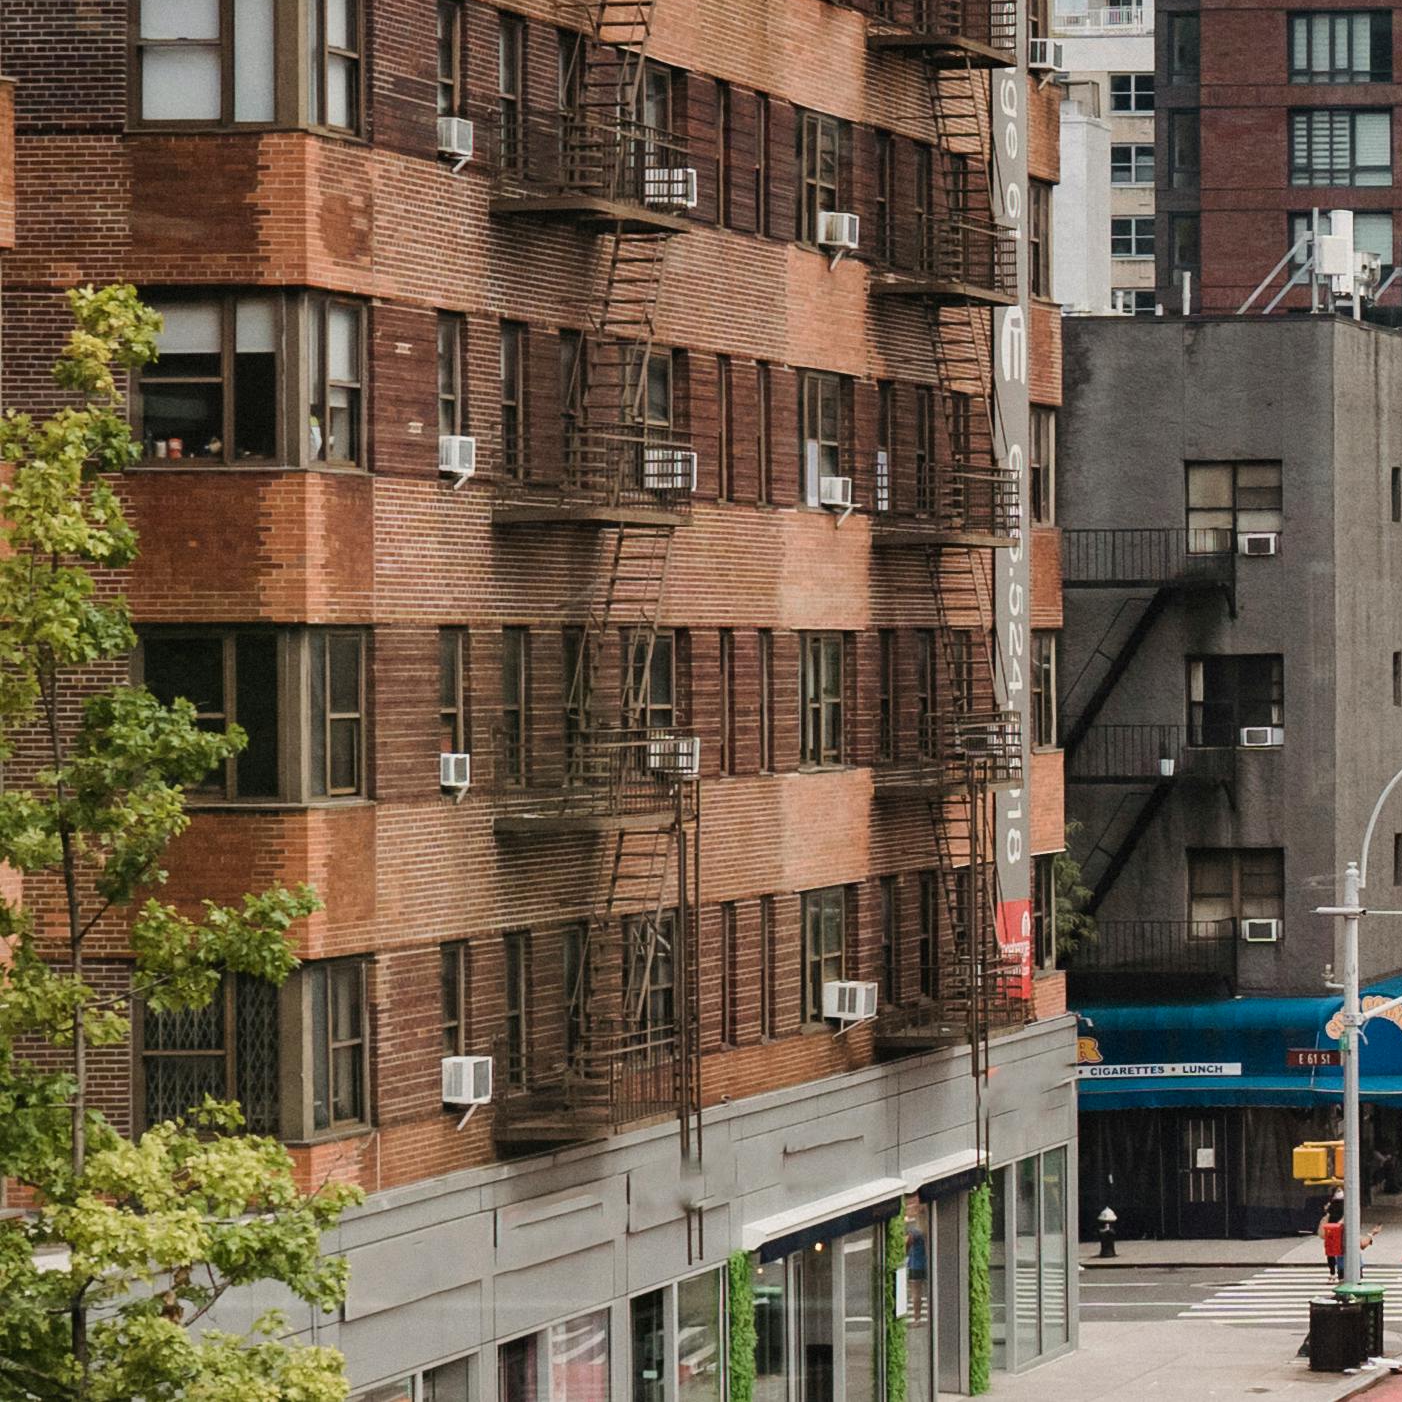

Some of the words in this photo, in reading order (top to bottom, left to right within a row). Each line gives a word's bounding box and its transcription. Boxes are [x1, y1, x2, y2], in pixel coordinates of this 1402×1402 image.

[1298, 1053, 1304, 1065] E
[1307, 1053, 1318, 1065] 61
[1320, 1053, 1331, 1065] St
[1089, 1065, 1165, 1077] CIGARETTES
[1182, 1064, 1223, 1074] LUNCH
